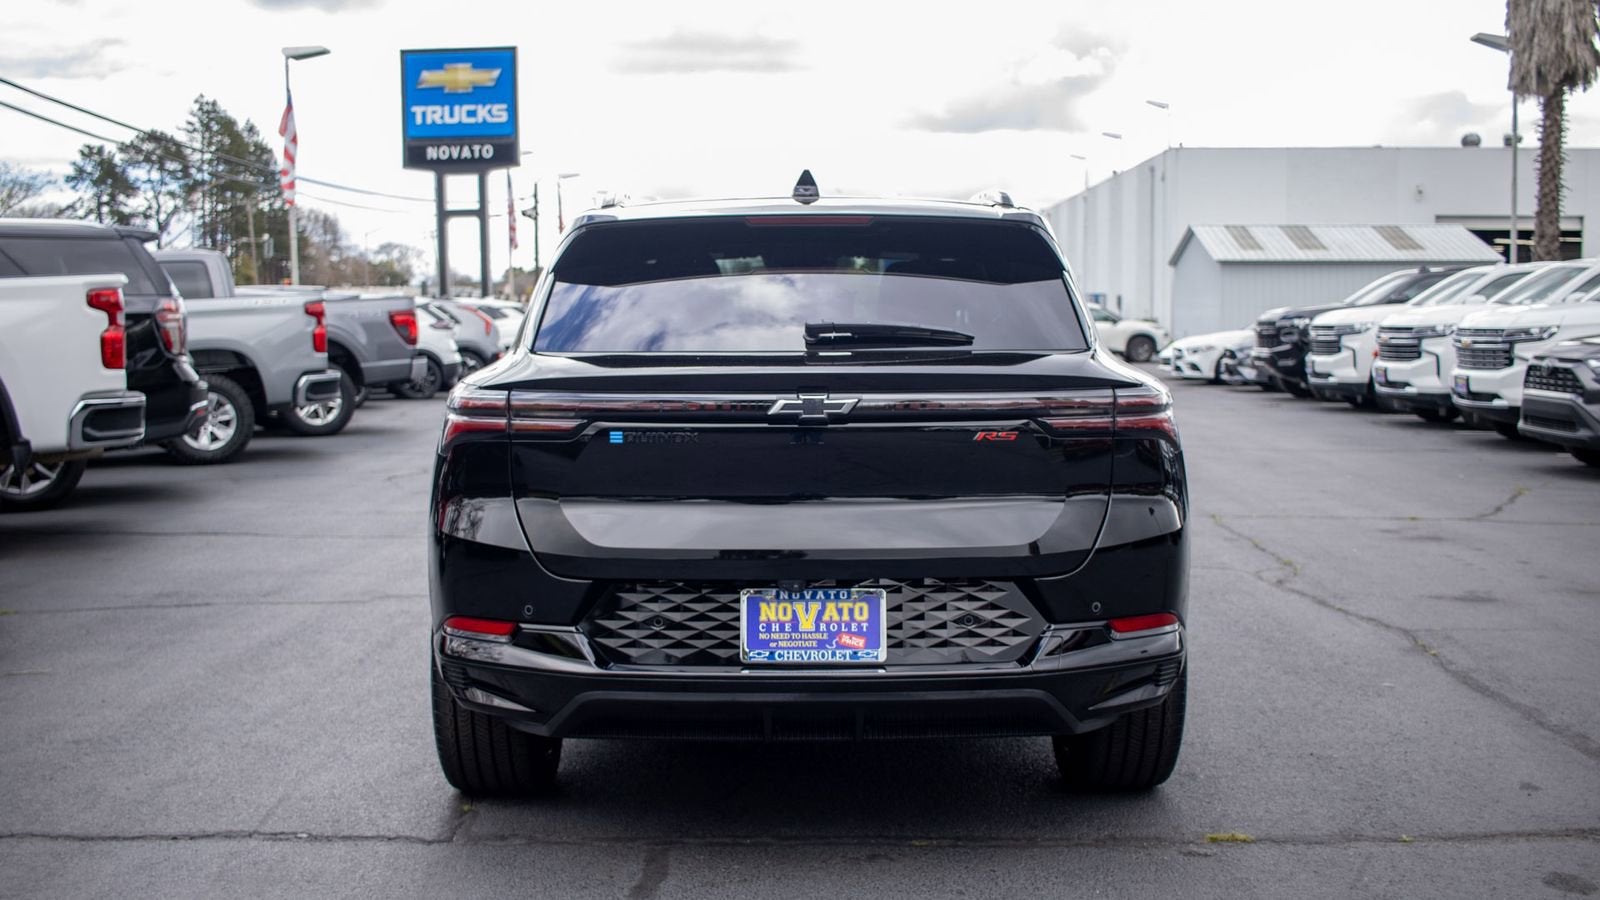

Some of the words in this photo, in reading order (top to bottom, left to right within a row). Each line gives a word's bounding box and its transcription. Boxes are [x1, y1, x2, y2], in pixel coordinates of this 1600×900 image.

[411, 103, 508, 125] TRUCKS
[426, 144, 494, 160] NOVATO
[973, 431, 1019, 441] RS
[779, 590, 848, 600] NOVATO
[759, 601, 869, 630] NOVATO
[775, 650, 852, 661] CHEVROLET
